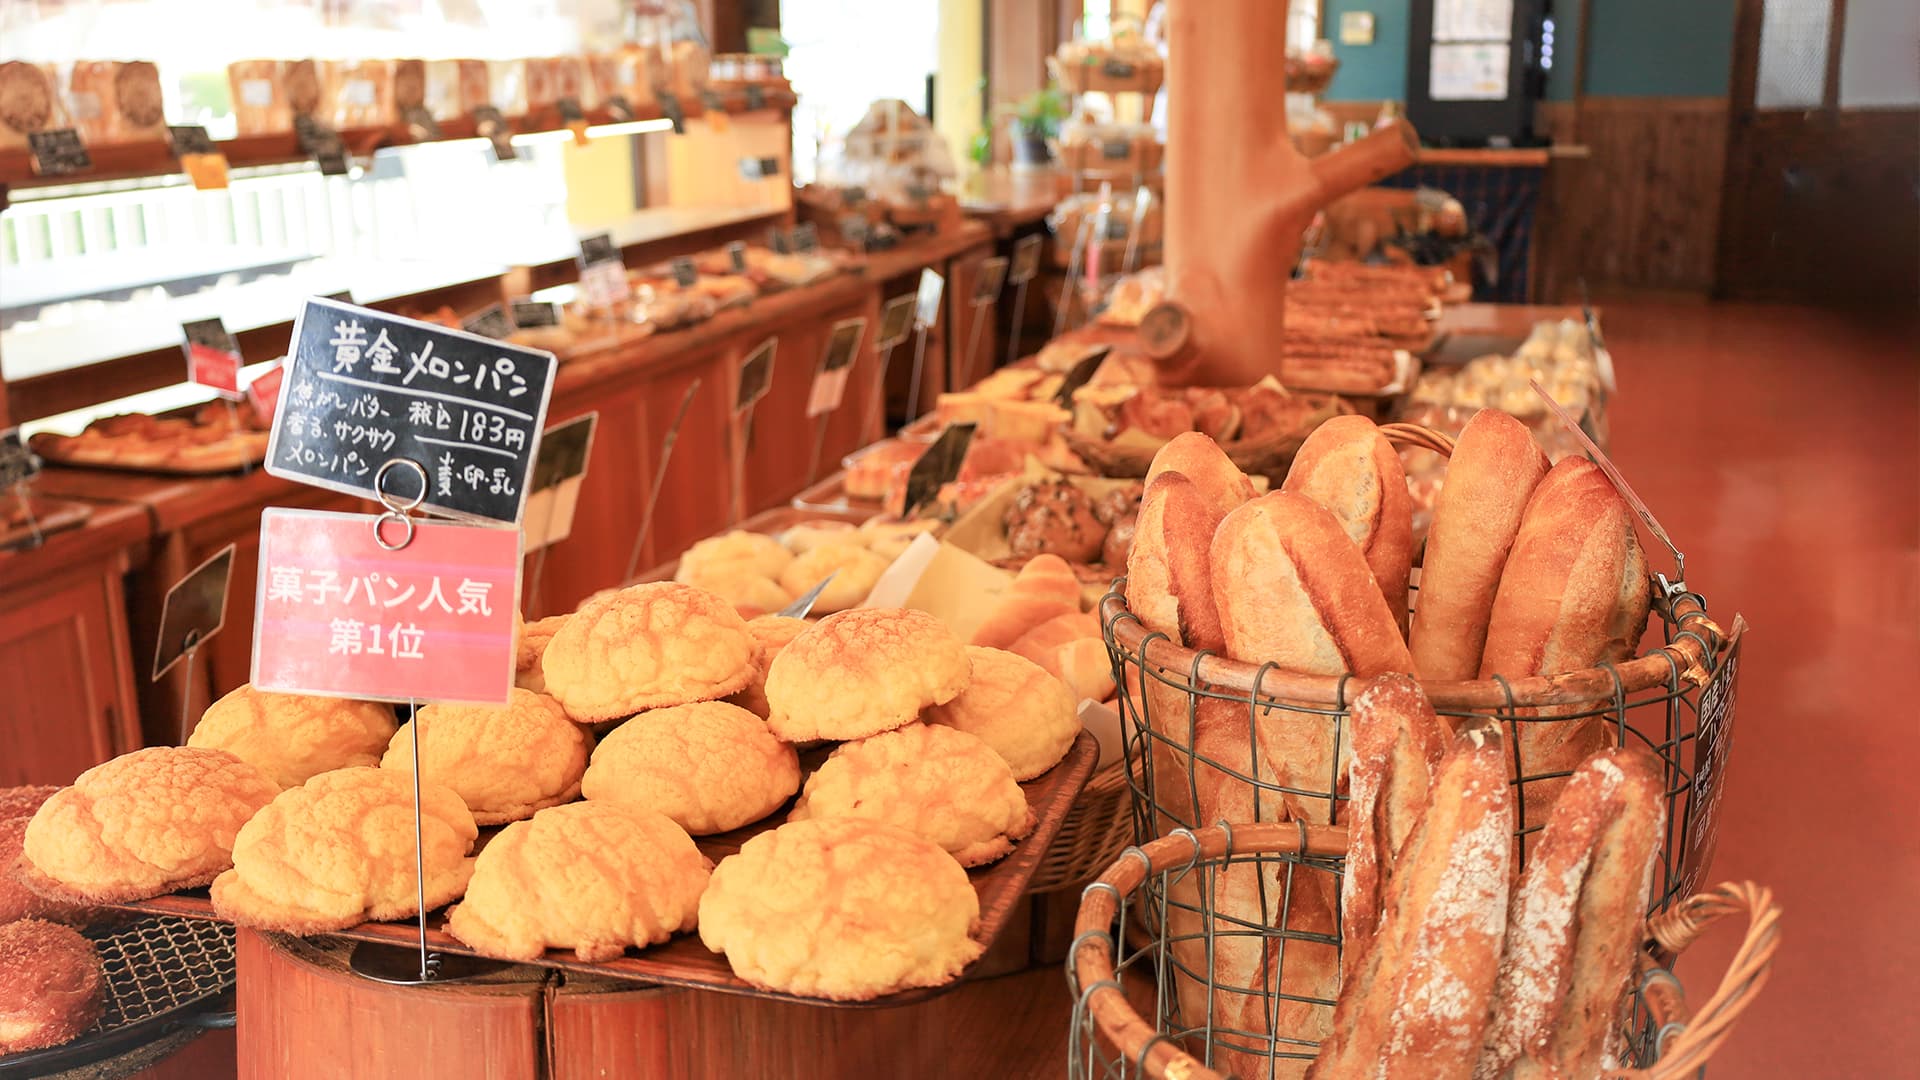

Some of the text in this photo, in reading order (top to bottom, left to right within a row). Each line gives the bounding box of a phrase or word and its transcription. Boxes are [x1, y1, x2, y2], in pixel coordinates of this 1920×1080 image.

[329, 319, 528, 397] 黄金メロンパン
[285, 440, 369, 476] メロンパン
[267, 566, 493, 616] 菓子パン人気
[328, 617, 425, 659] 第1位
